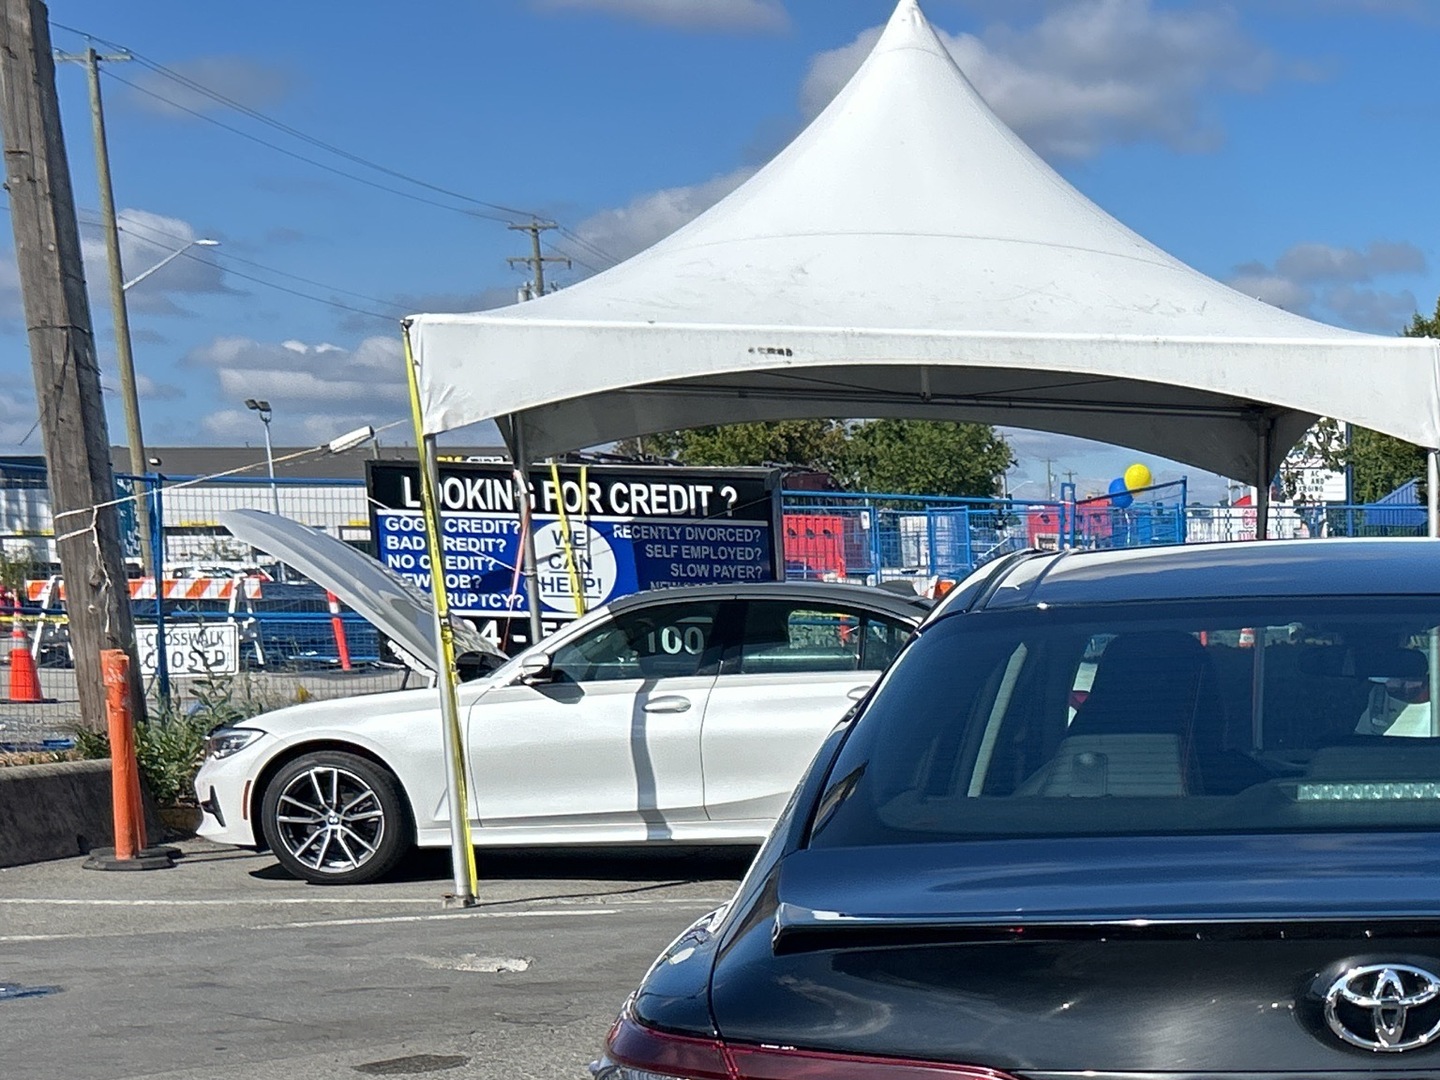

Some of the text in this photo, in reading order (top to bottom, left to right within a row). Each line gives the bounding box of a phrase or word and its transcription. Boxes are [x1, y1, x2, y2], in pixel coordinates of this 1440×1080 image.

[403, 476, 536, 511] LOKIN
[543, 480, 604, 513] FOR
[609, 482, 713, 516] CREDIT
[385, 517, 521, 535] GOO CREDIT?
[613, 524, 761, 543] RECENTLY DIVORCED?
[386, 536, 507, 553] BAD REDIT?
[645, 544, 762, 562] SELF EMPLOYED?
[388, 554, 497, 571] NO CEDIT?
[670, 563, 763, 580] SLOW PAYER?
[446, 574, 483, 589] OB?
[447, 593, 525, 609] RUPTCY?
[145, 631, 225, 647] COSSWALK
[145, 650, 226, 669] COSD
